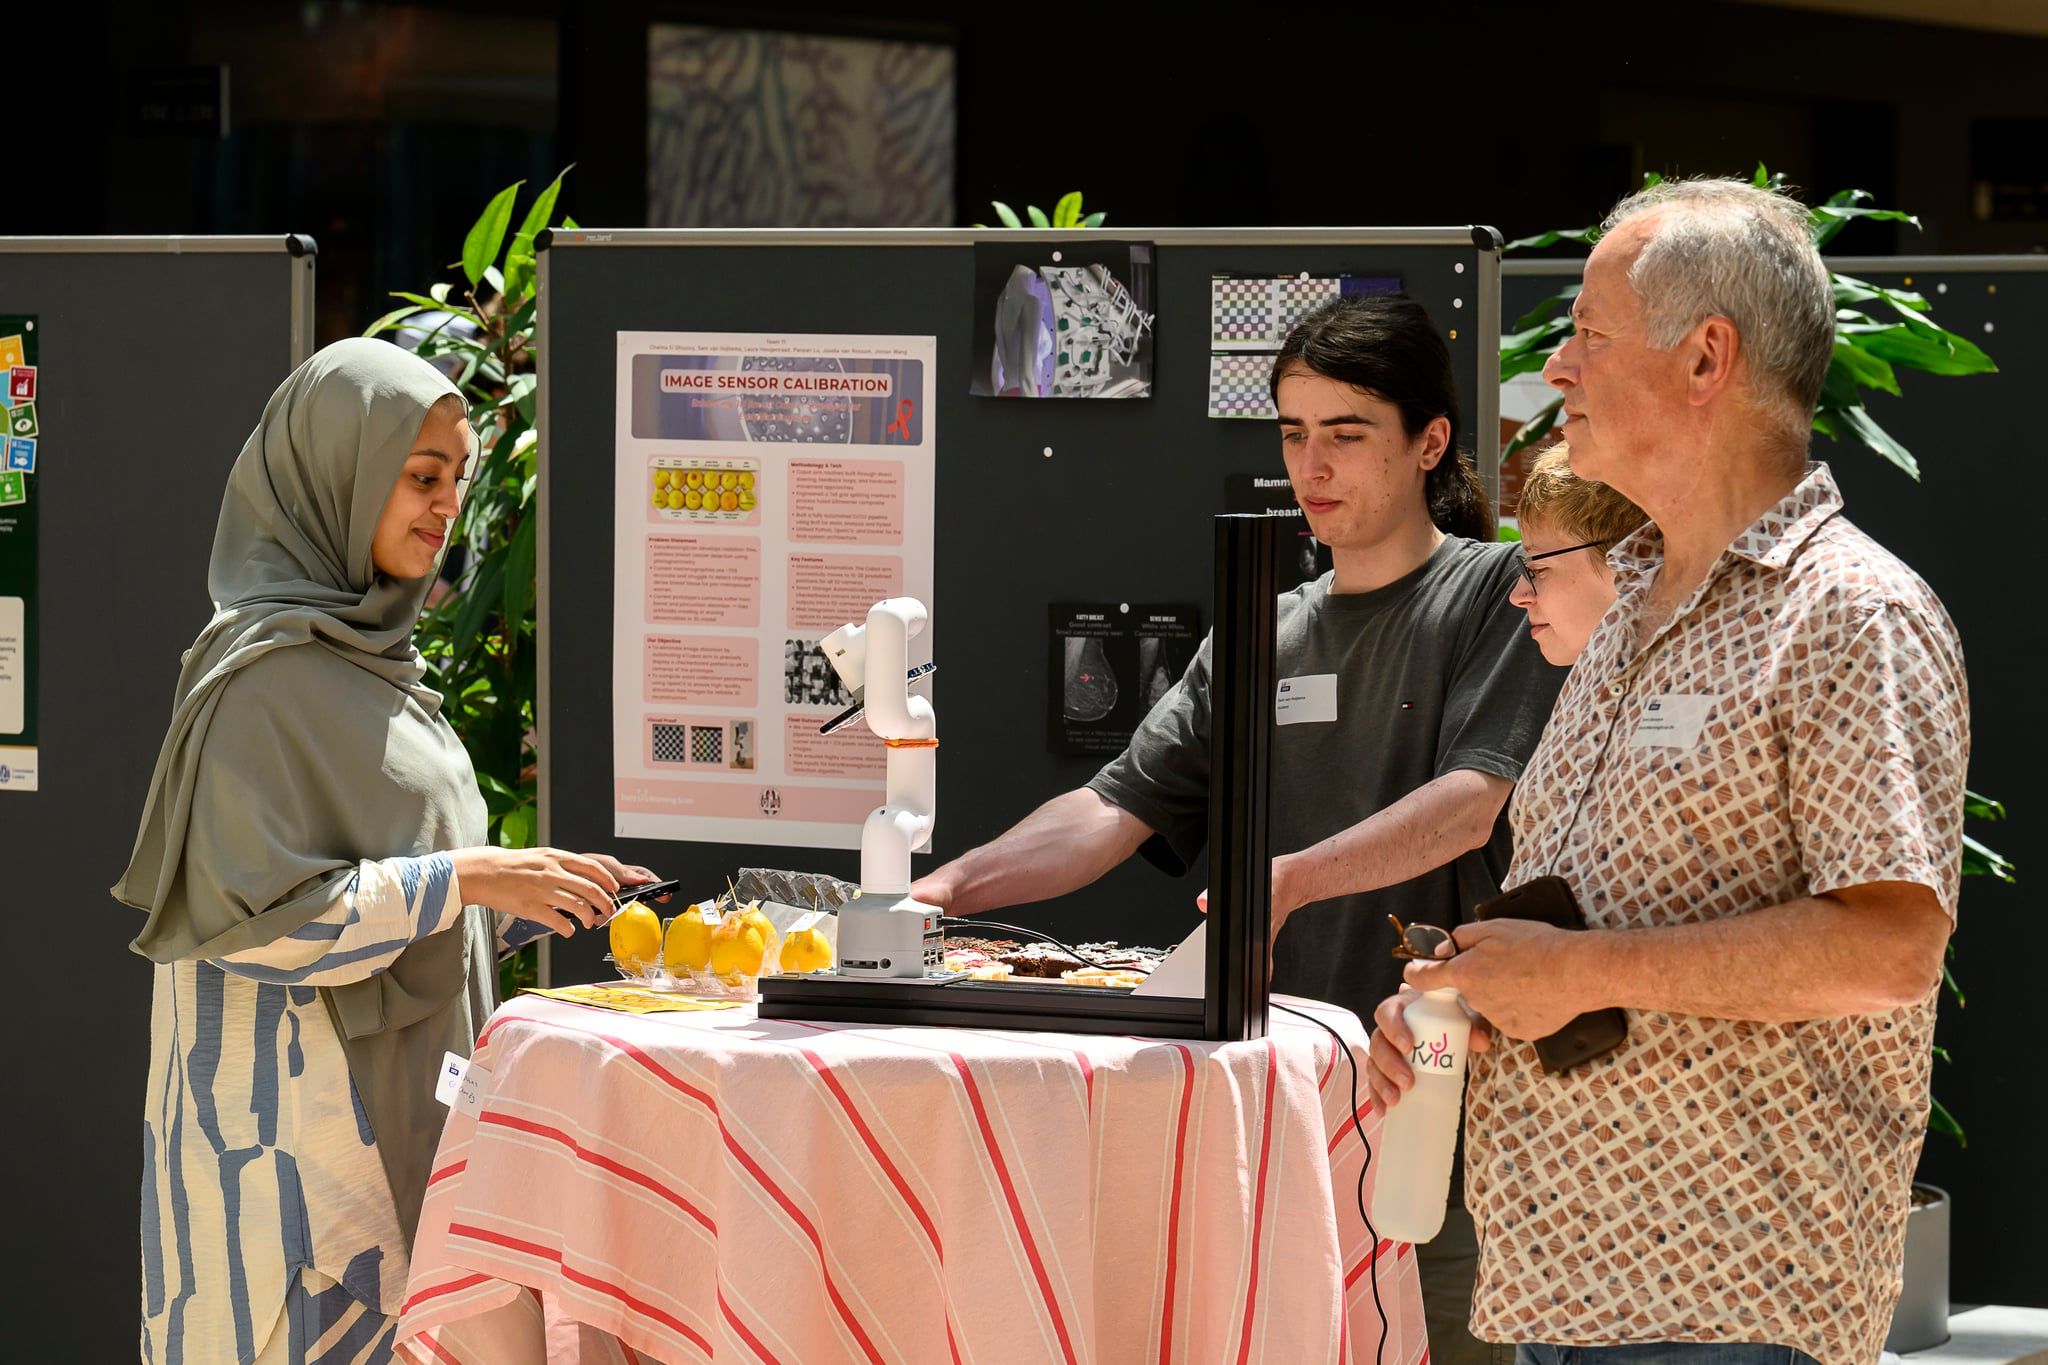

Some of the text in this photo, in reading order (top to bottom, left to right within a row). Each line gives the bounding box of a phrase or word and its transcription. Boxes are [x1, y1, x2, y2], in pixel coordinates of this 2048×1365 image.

[664, 375, 889, 392] IMAGE SENSOR CALIBRATION
[1266, 507, 1303, 517] breast
